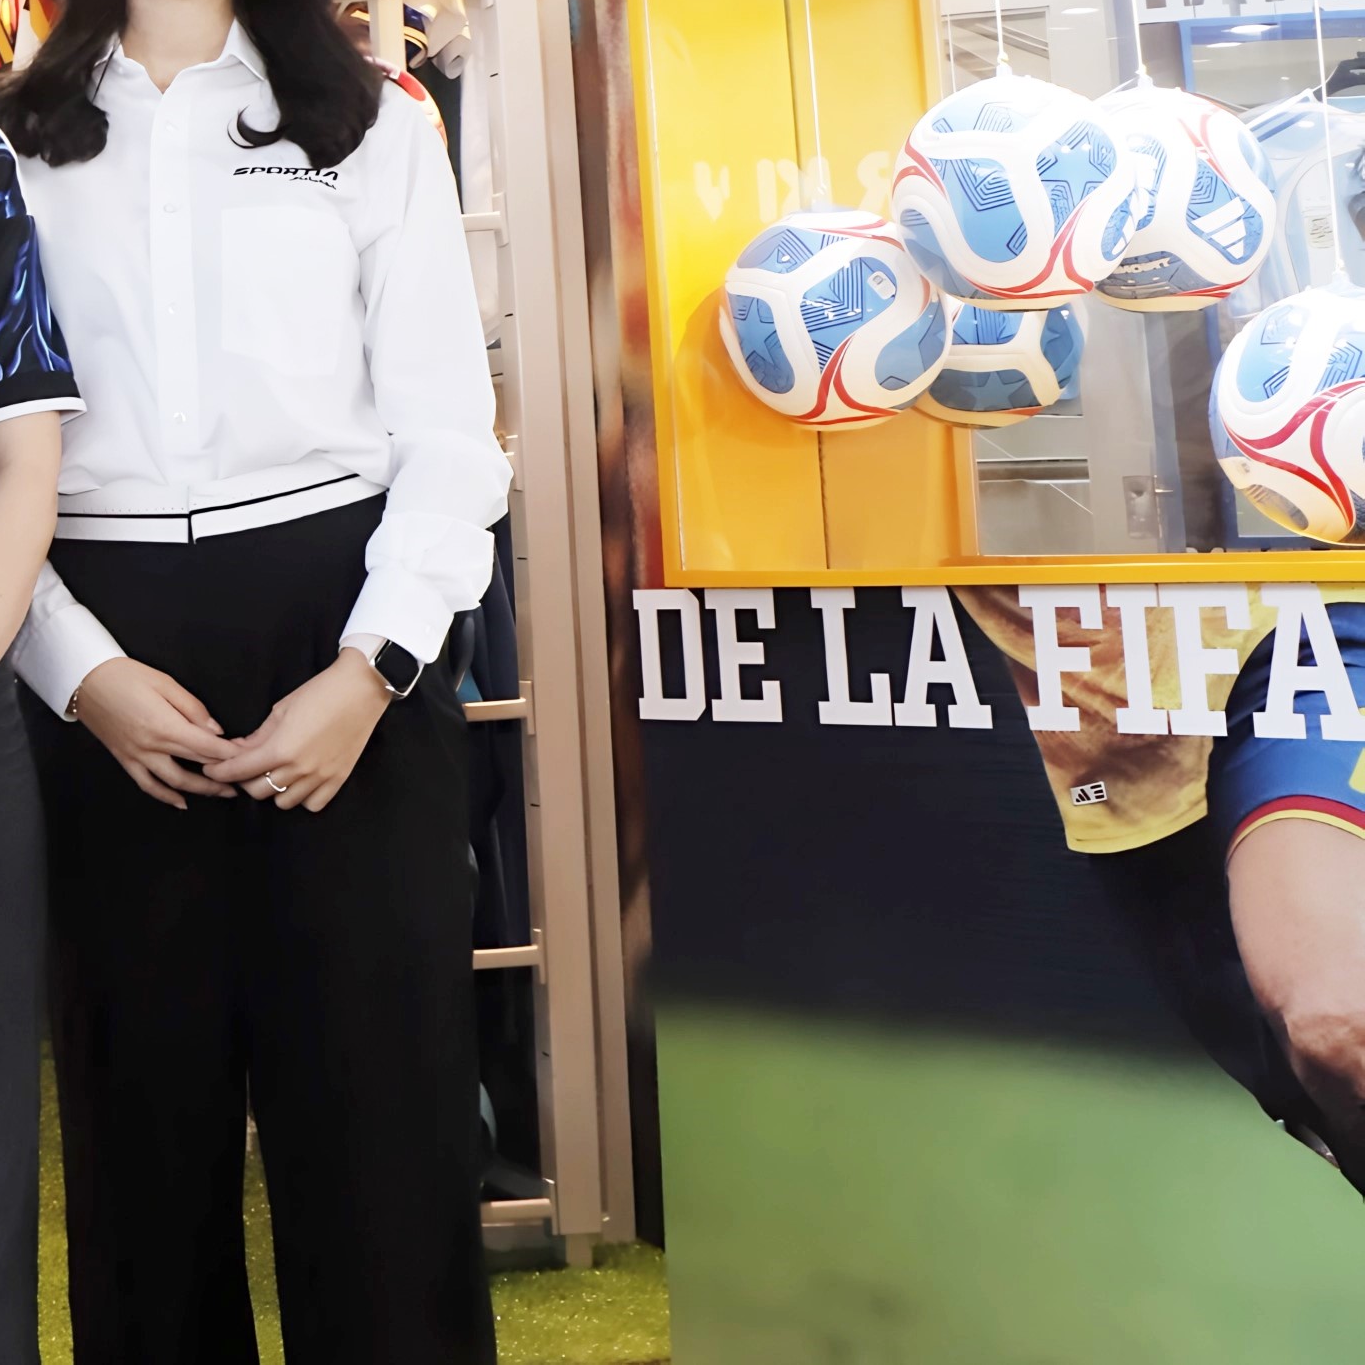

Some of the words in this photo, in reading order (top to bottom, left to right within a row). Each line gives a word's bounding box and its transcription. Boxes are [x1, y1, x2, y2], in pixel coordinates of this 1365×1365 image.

[632, 588, 783, 723] DE
[810, 585, 993, 729] LA
[1019, 582, 1365, 742] FIFA
